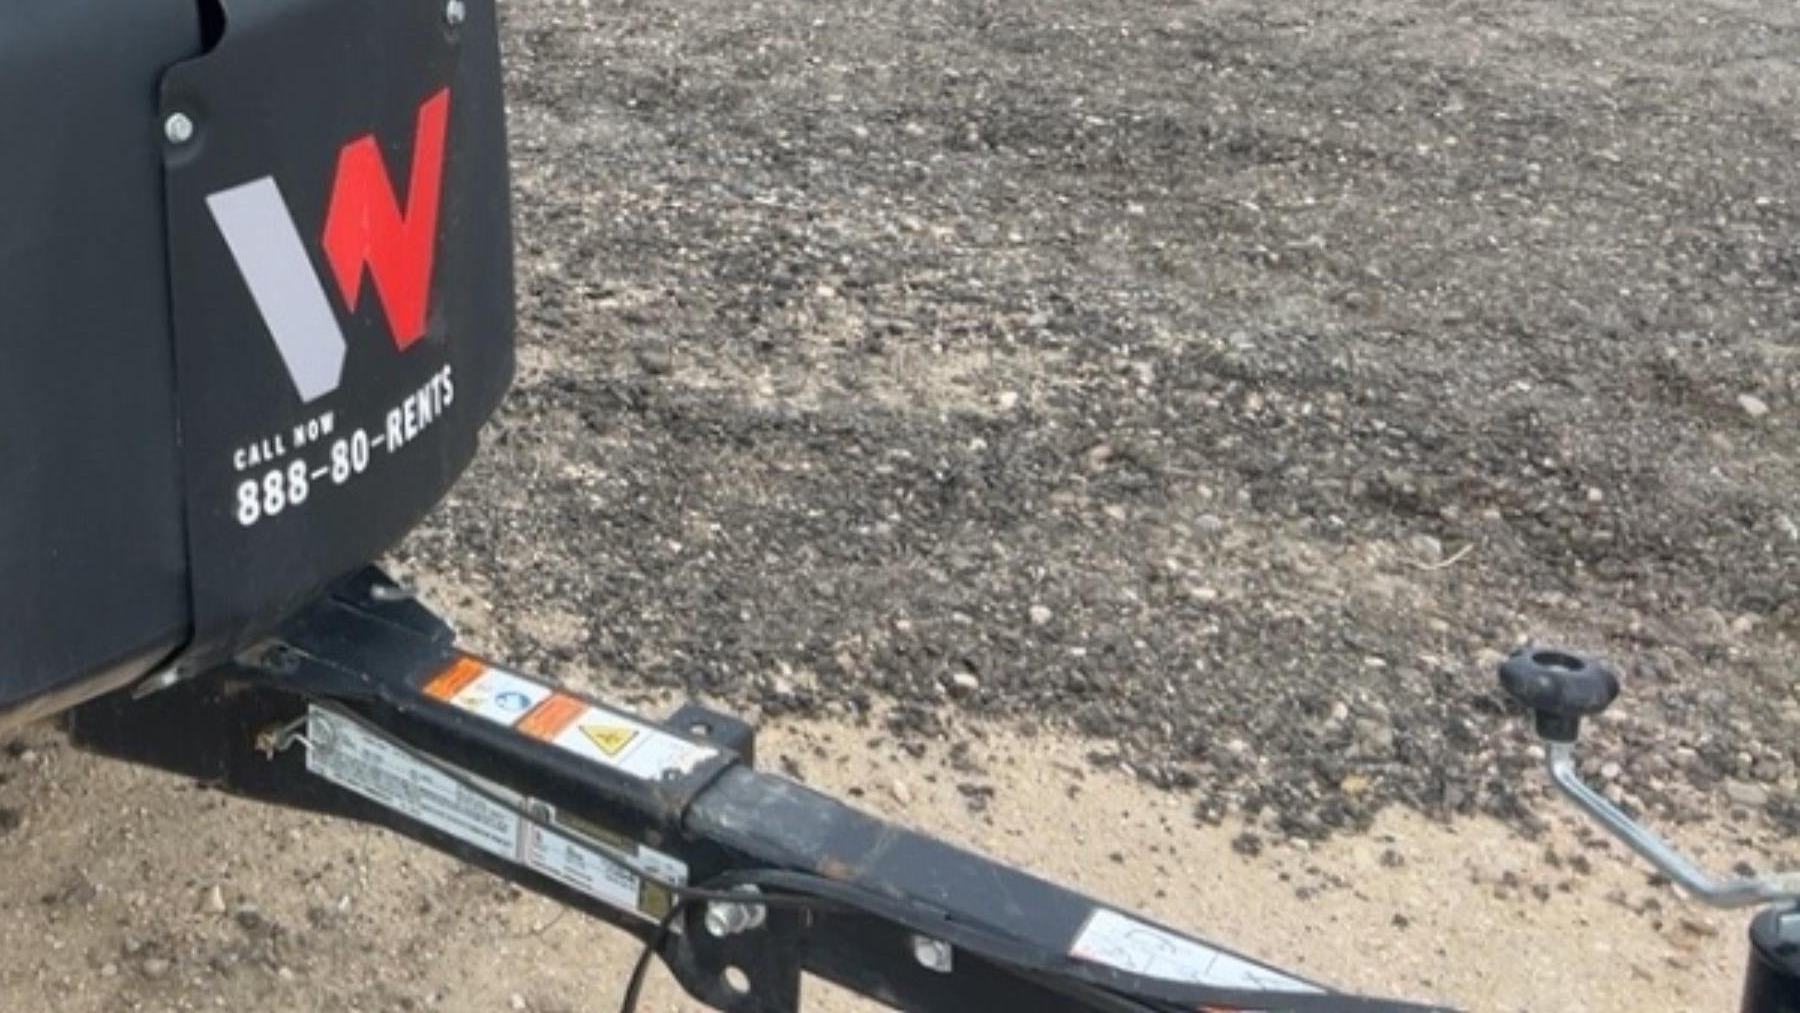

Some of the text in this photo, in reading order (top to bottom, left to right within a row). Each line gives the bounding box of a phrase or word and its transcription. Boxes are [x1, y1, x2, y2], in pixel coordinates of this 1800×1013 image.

[234, 410, 335, 471] CALL NOW
[236, 364, 455, 526] 888-80-RENTS
